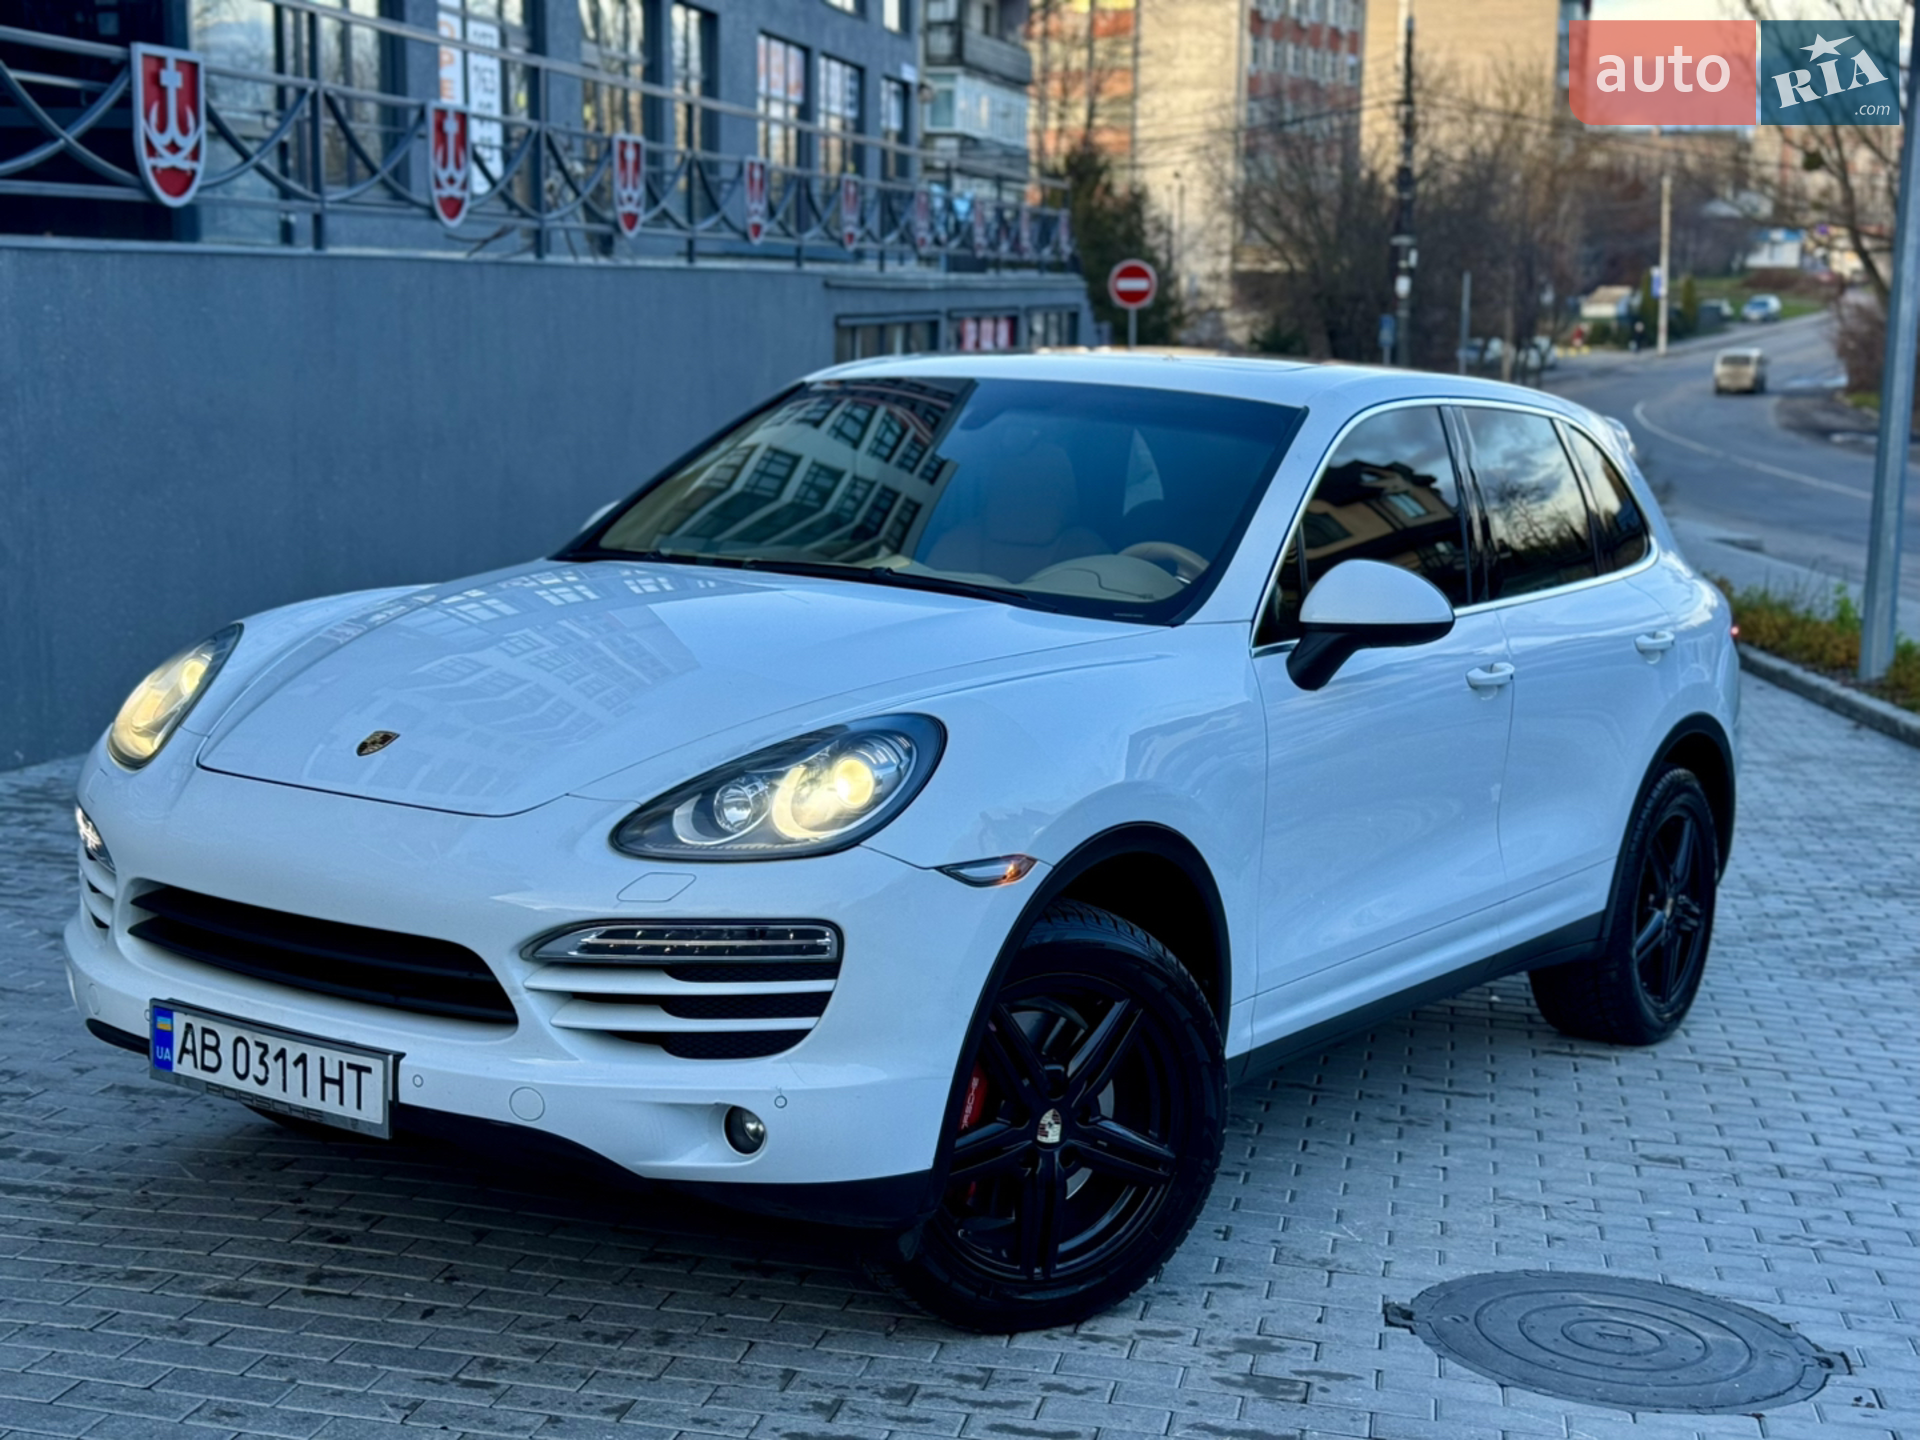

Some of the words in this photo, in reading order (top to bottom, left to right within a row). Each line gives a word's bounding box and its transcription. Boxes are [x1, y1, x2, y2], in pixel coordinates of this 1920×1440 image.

[155, 1045, 172, 1063] UA
[177, 1022, 223, 1074] AB
[232, 1035, 308, 1099] 0311
[319, 1055, 373, 1111] HT
[205, 1082, 326, 1122] PORSCHE
